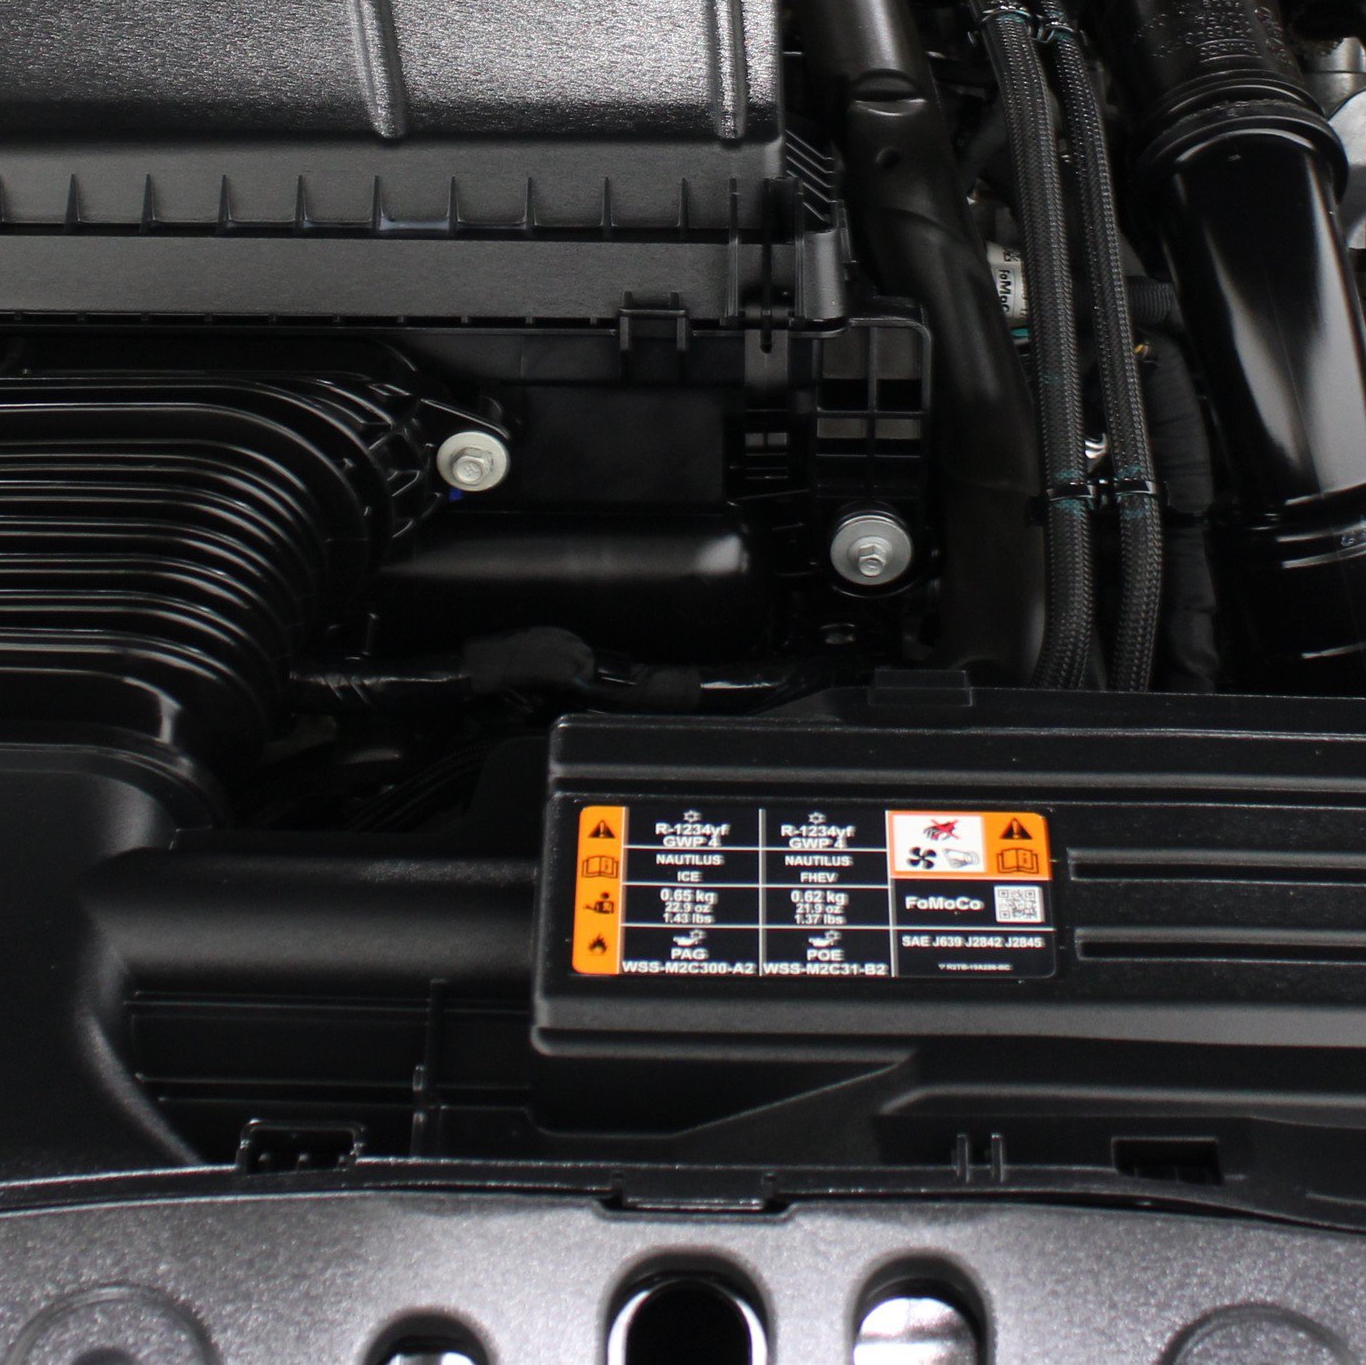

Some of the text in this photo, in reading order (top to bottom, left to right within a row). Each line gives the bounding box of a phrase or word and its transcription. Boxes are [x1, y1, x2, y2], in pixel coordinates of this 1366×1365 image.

[655, 822, 730, 839] R-1234yf
[780, 824, 856, 841] R-1234yf
[663, 835, 722, 847] GWP 4
[788, 838, 848, 849] GWP 4
[656, 854, 725, 866] NAUTILUS
[784, 855, 854, 867] NAUTILUS
[677, 871, 704, 882] ICE
[799, 872, 840, 883] FHEV
[660, 888, 719, 905] 0.65 kg
[790, 889, 850, 906] 0.62 kg
[905, 895, 985, 910] FoMoCo
[664, 902, 714, 913] 22.9 oz
[795, 903, 845, 914] 21.9 oz
[692, 913, 715, 924] lbs
[794, 914, 848, 925] 1.37 lbs
[902, 935, 1046, 949] SAE J639 J2842 J2845
[670, 947, 710, 960] PAG
[806, 949, 846, 962] POE
[622, 960, 757, 974] WSS-M2C300-A2
[763, 962, 889, 976] WSS-M2C31-B2
